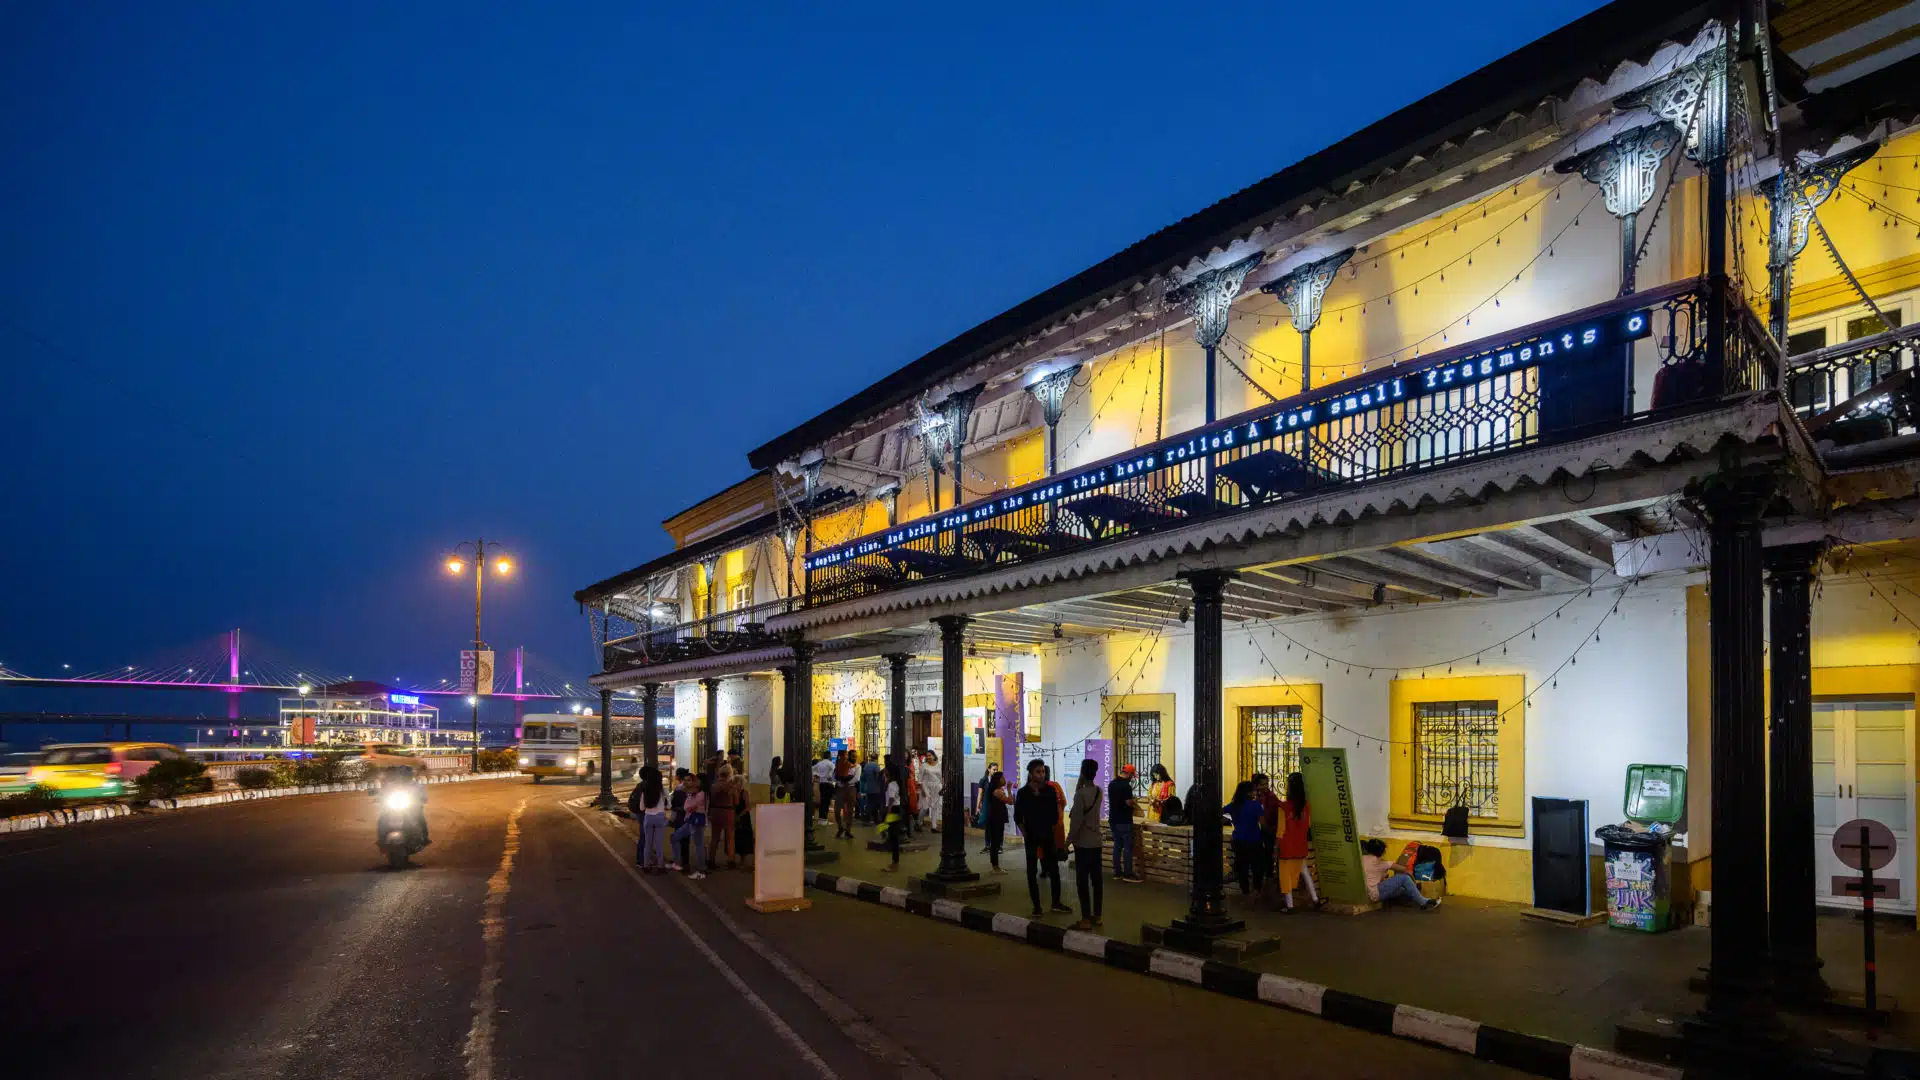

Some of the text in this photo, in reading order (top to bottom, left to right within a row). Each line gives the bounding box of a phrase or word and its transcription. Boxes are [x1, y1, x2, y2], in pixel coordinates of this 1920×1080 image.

[815, 551, 841, 567] depths
[845, 547, 854, 558] of
[859, 541, 882, 553] time,
[887, 533, 903, 545] And
[908, 523, 937, 538] bring
[943, 513, 968, 527] from
[974, 504, 994, 518] out
[1003, 496, 1023, 509] the
[1032, 484, 1063, 501] ages
[1073, 471, 1105, 489] that
[1116, 455, 1155, 477] have
[1166, 430, 1234, 462] rolled
[1248, 422, 1259, 438] A
[1274, 409, 1314, 431] few
[1331, 379, 1403, 415] small
[1425, 328, 1597, 387] fragments
[1332, 756, 1353, 842] REGISTRATION
